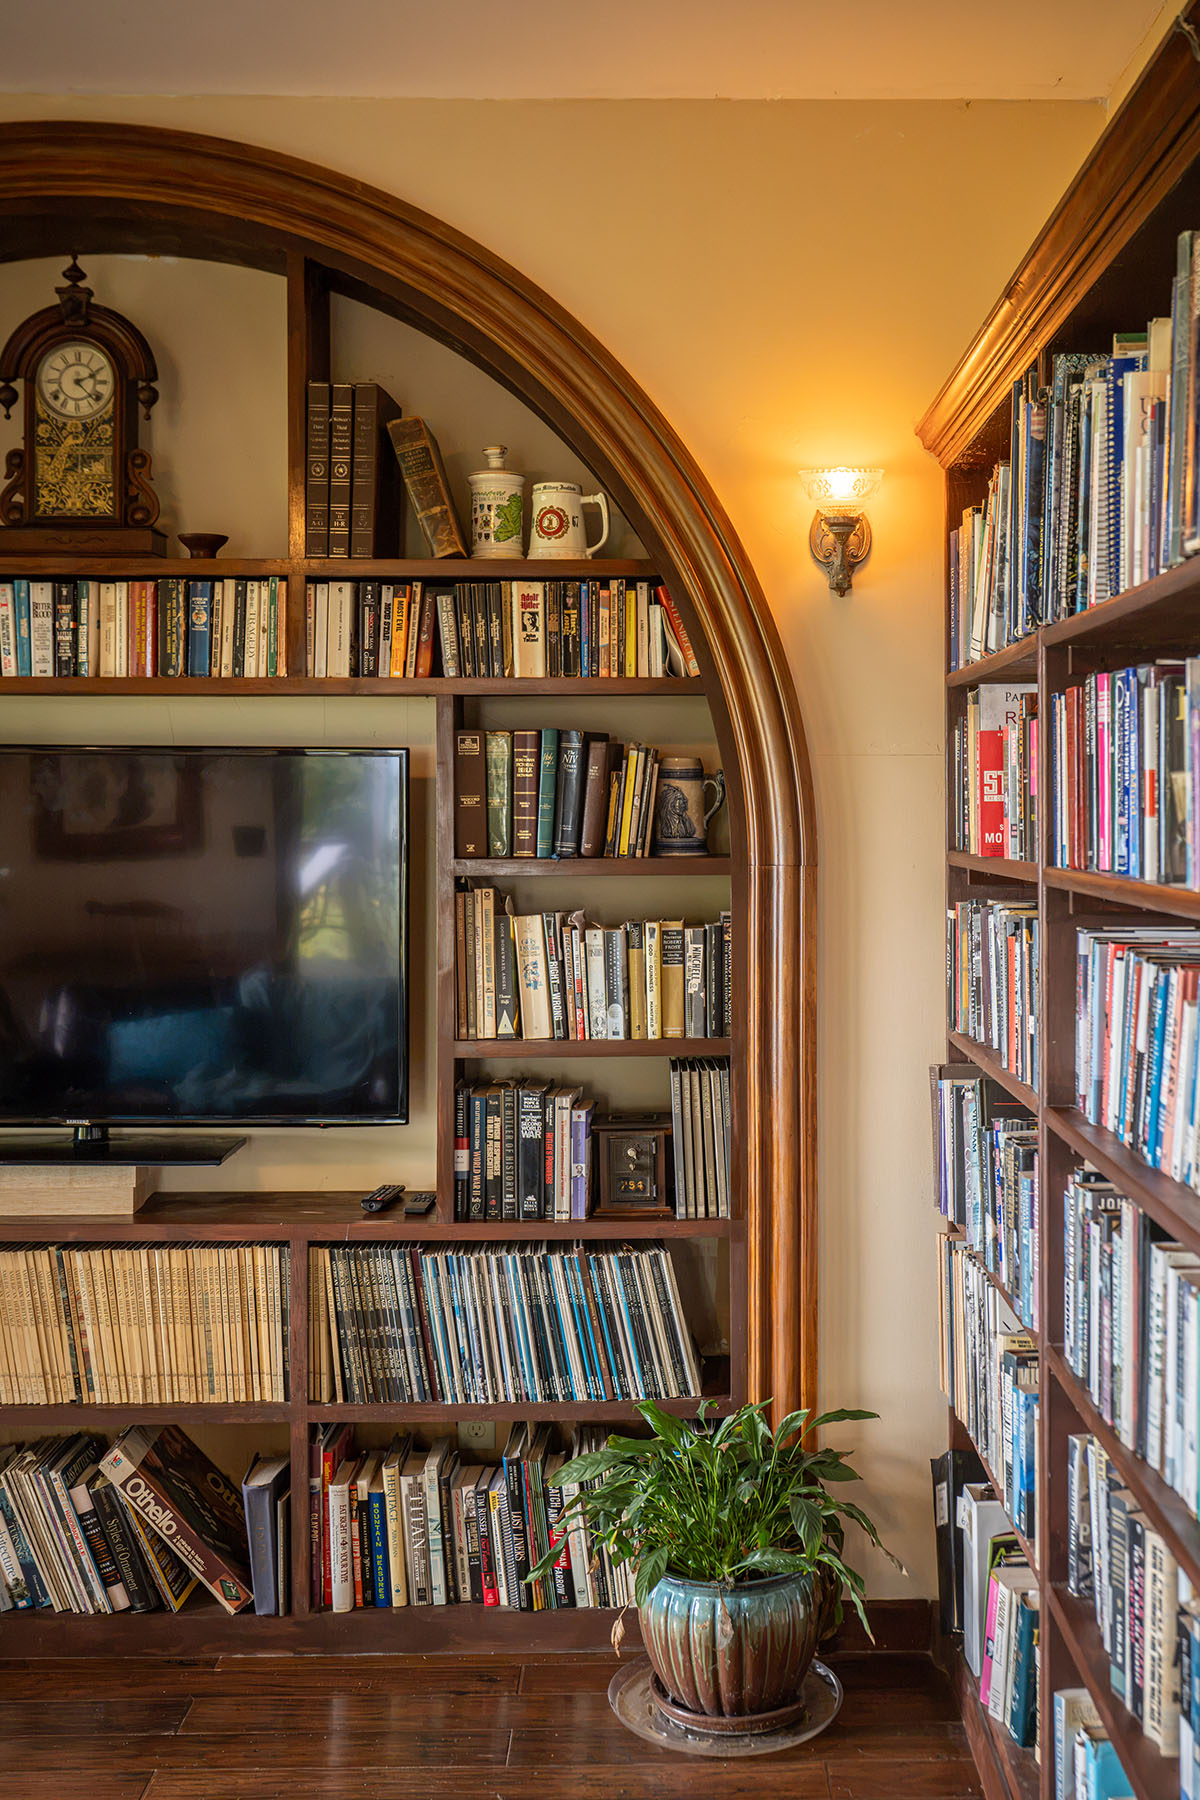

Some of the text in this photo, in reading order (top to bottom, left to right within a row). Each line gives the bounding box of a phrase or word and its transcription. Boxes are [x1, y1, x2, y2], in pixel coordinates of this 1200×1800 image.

[32, 601, 51, 610] BITTER
[521, 593, 539, 601] Adolf
[32, 610, 51, 619] BLOOD
[563, 754, 578, 763] NIV
[550, 961, 559, 984] RIGHT
[692, 947, 701, 980] WINCHELL
[553, 992, 562, 1021] WRONG
[505, 1092, 514, 1192] THE HITLER OF HISTORY
[473, 1151, 481, 1174] WORLD
[126, 1477, 179, 1536] Othello
[339, 1505, 347, 1515] EAT
[385, 1474, 398, 1524] HERITAGE
[477, 1494, 488, 1536] TIM RUSSERT
[65, 1509, 79, 1541] HANDMADE
[409, 1492, 426, 1549] TITAN
[511, 1511, 525, 1561] LOST LINERS
[8, 1522, 26, 1561] TURNING
[373, 1503, 384, 1600] MOUNTAIN MEASURES
[470, 1522, 479, 1553] EMPIRE
[106, 1518, 139, 1592] Styles of Ornament
[554, 1566, 565, 1595] FARROW
